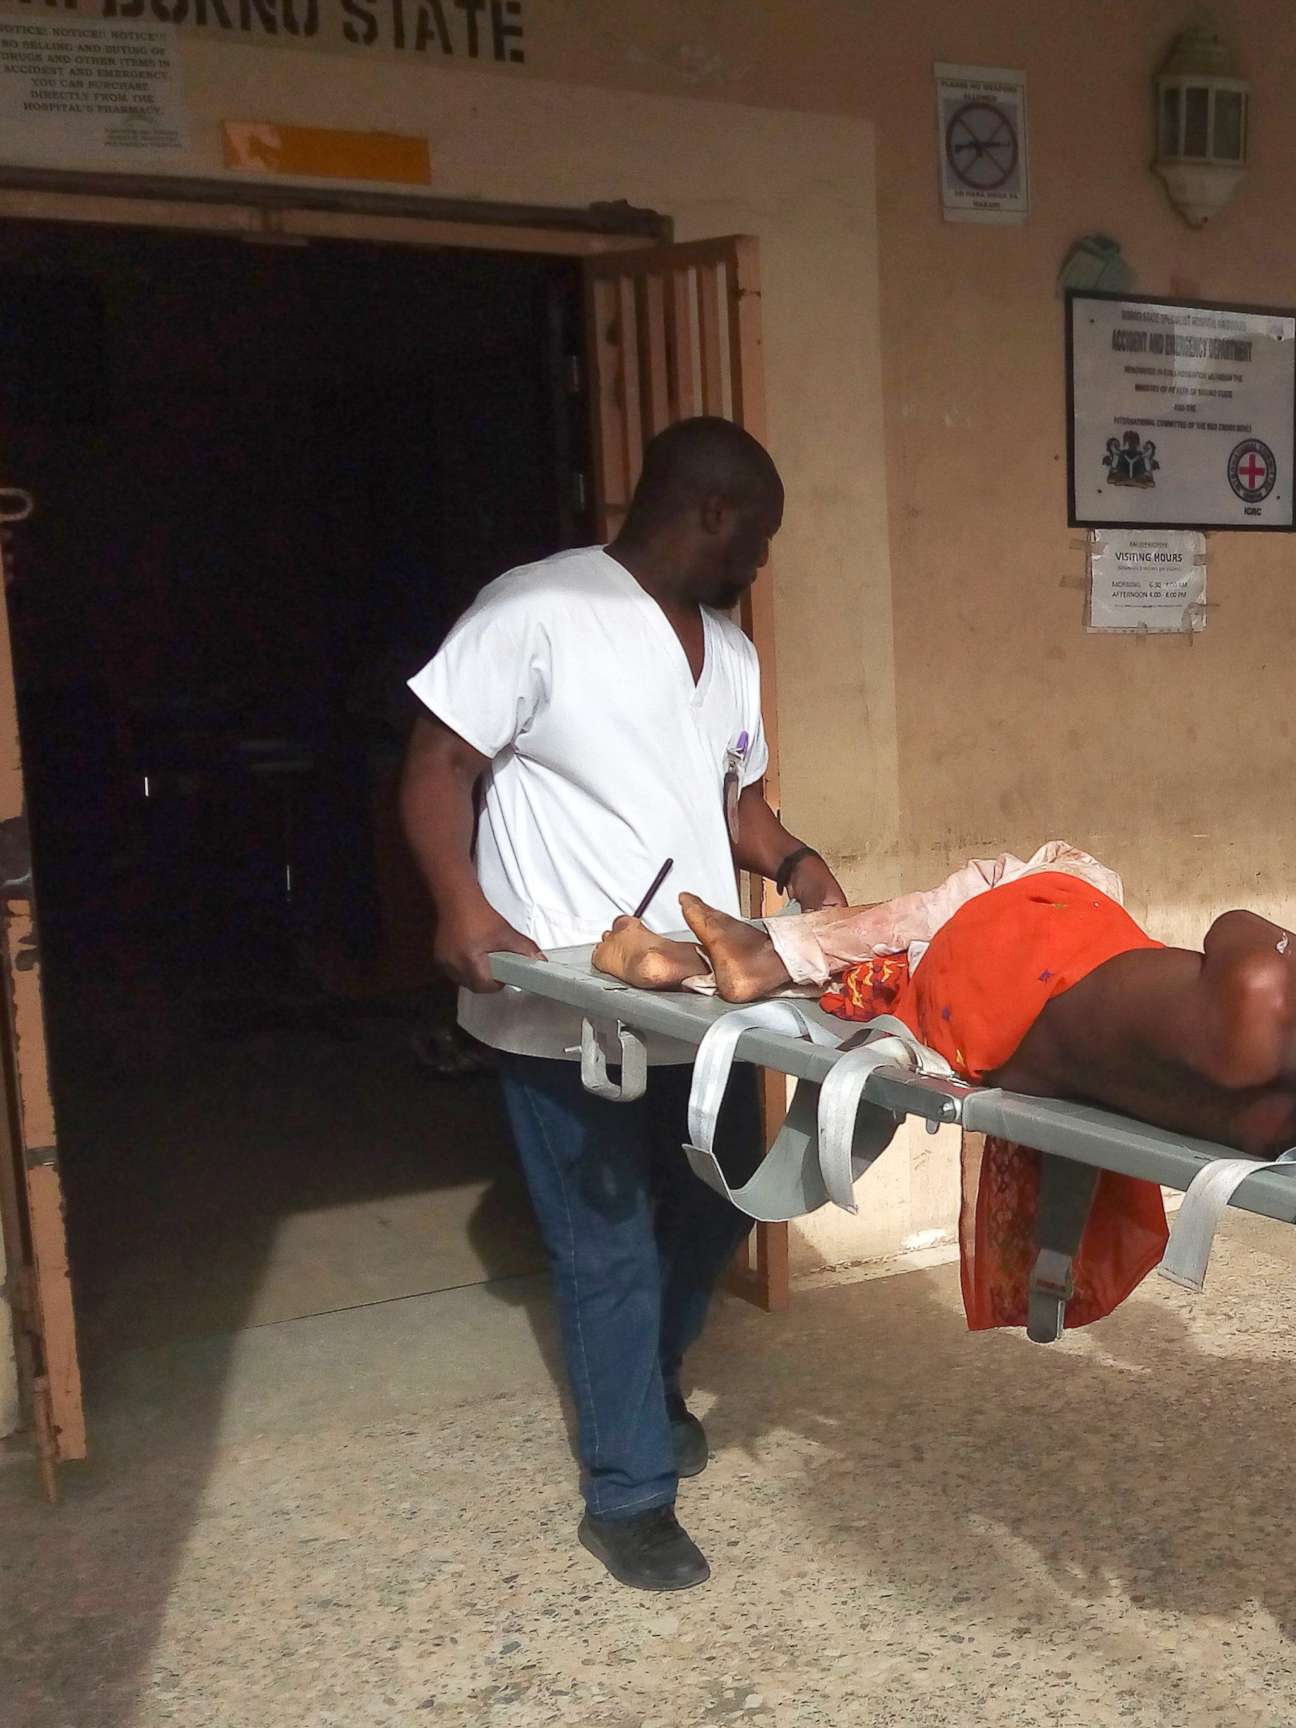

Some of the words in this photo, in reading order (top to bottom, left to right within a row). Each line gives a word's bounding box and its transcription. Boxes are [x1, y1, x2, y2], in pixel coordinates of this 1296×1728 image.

[340, 0, 525, 63] STATE
[2, 39, 18, 48] NO
[22, 40, 73, 51] SELLING
[78, 43, 102, 53] AND
[105, 45, 148, 55] BUYING
[150, 47, 165, 56] OF
[1, 51, 42, 62] DRUGS
[47, 54, 71, 64] AND
[74, 55, 116, 66] OTHER
[4, 64, 64, 76] ACCIDENT
[69, 67, 93, 77] AND
[96, 69, 168, 80] EMERGENCY
[31, 77, 57, 88] YOU
[60, 79, 84, 89] CAN
[88, 80, 149, 91] PURCHASE
[30, 89, 91, 101] DIRECTLY
[94, 92, 129, 103] FROM
[132, 94, 156, 104] THE
[1149, 332, 1165, 355] AND
[1115, 551, 1152, 563] VISITING
[1154, 552, 1183, 563] HOURS
[1112, 591, 1148, 599] AFTERNOON
